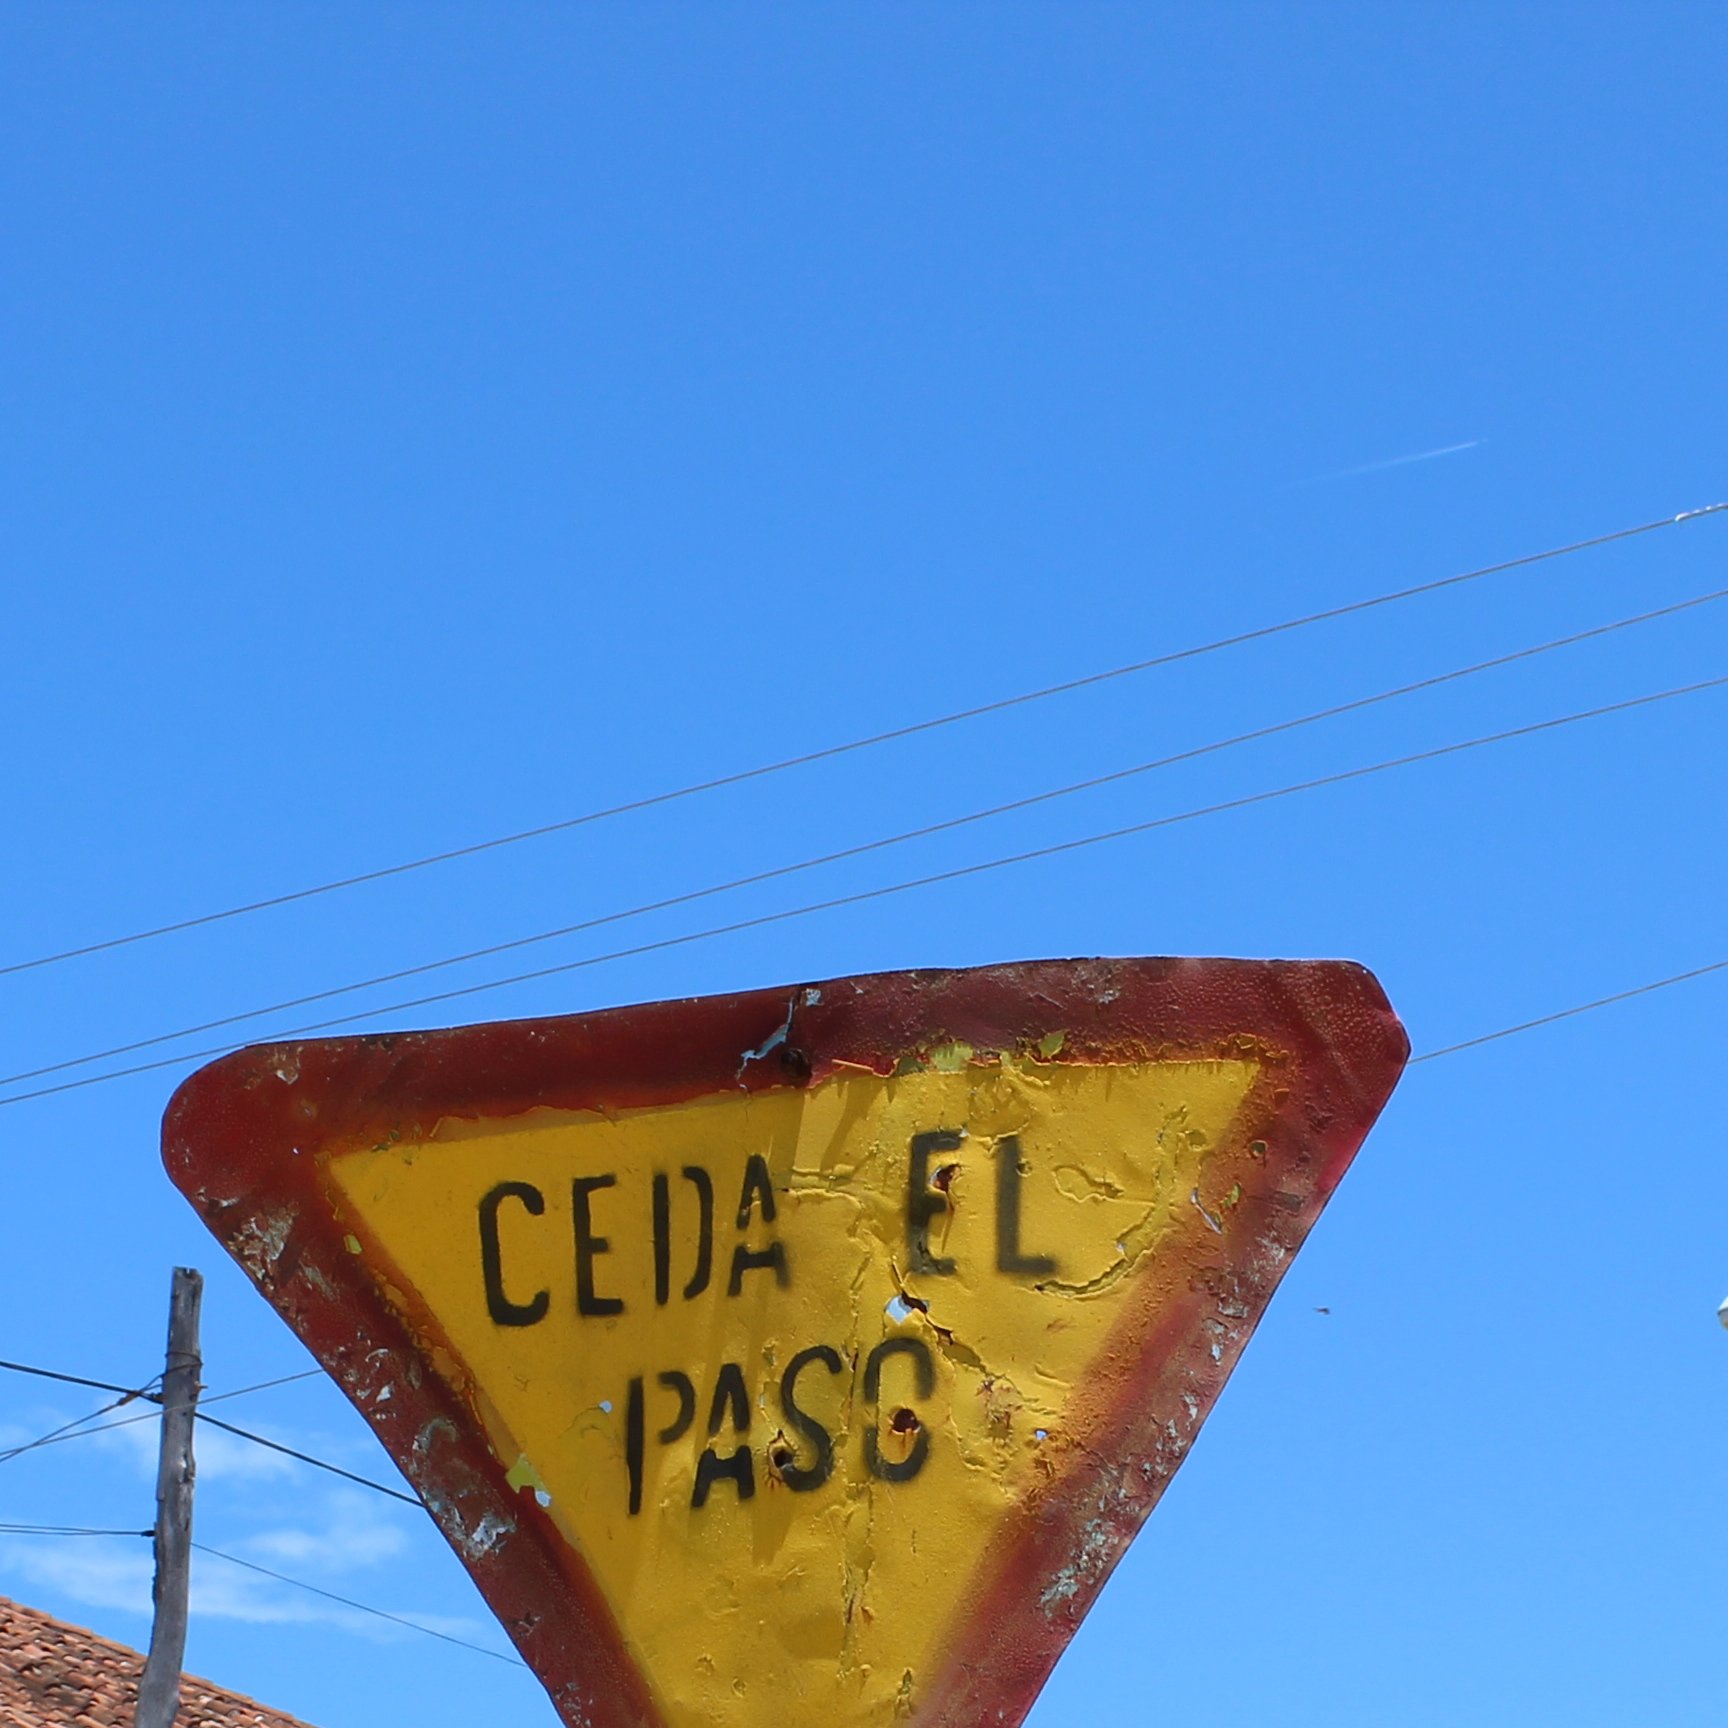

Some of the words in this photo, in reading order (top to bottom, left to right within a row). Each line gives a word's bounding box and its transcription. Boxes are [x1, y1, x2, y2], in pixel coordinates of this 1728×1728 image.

[478, 1153, 790, 1327] CEDA
[907, 1128, 1060, 1277] EL
[626, 1337, 936, 1516] PASO
